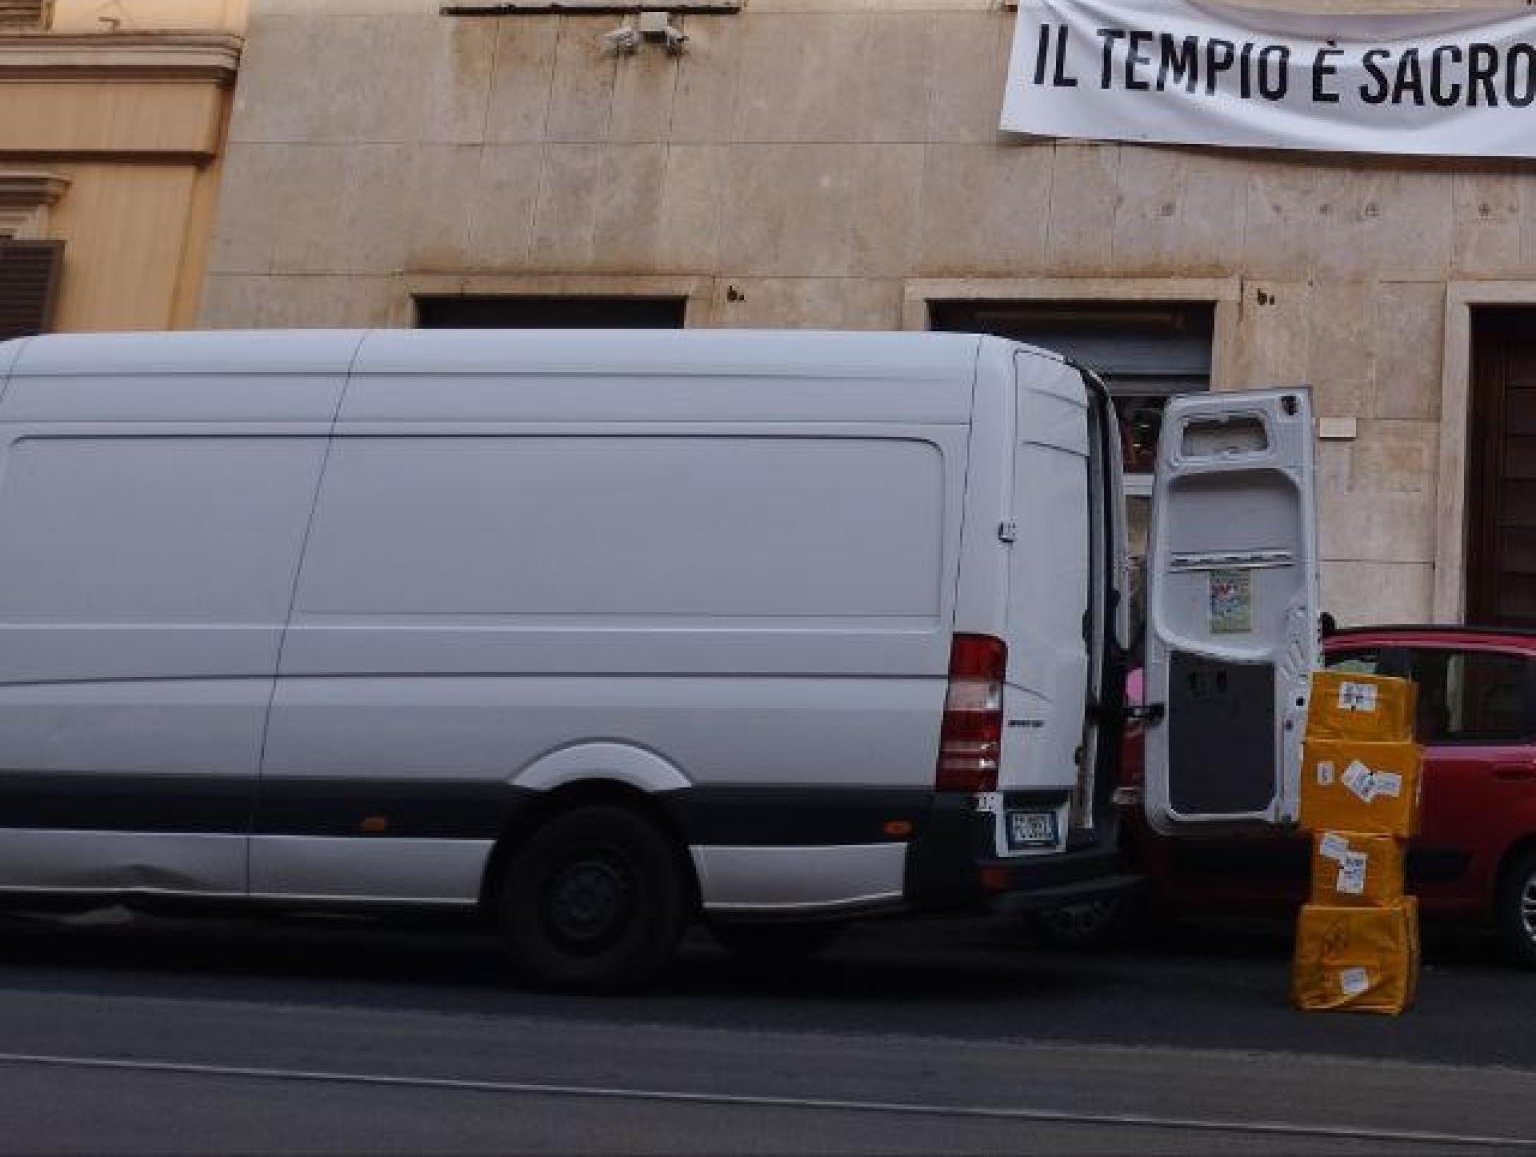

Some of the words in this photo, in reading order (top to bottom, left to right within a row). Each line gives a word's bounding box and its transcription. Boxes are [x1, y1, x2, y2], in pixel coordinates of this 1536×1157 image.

[1033, 23, 1077, 88] IL
[1099, 28, 1290, 102] TEMPIO
[1312, 39, 1344, 103] È
